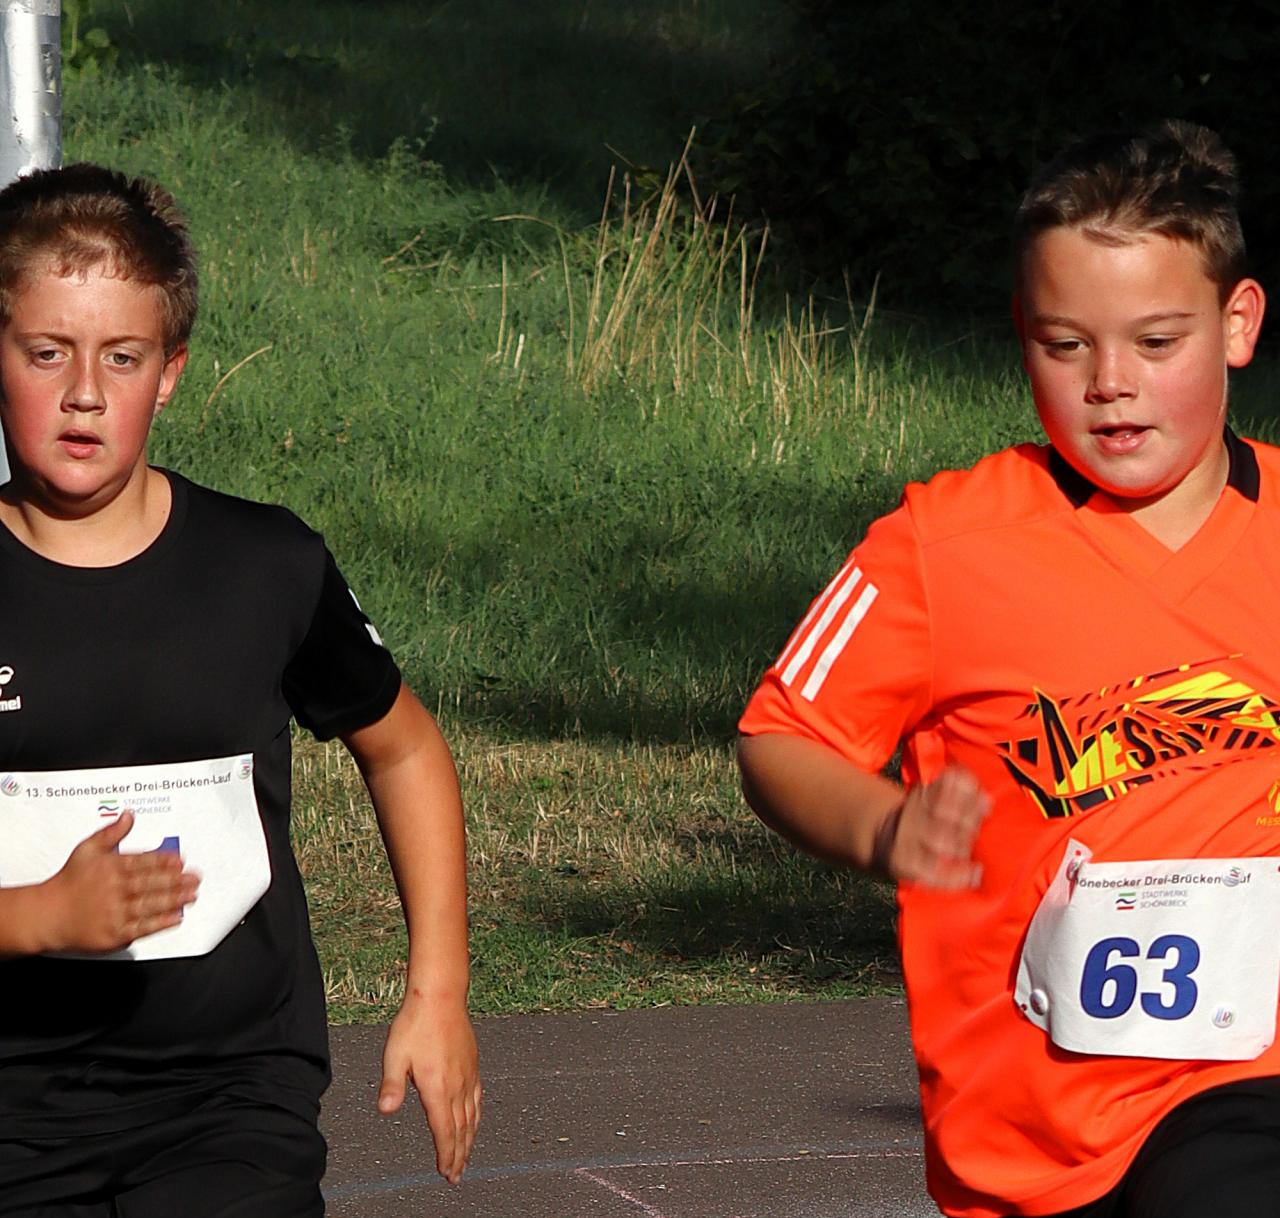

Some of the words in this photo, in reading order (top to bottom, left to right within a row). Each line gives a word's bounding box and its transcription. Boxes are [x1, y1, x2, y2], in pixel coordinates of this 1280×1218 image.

[25, 788, 43, 798] 13.
[46, 784, 130, 798] Schönebecker
[134, 773, 232, 792] Drei-Brücken-Lauf
[1141, 889, 1188, 899] STADTWERKE
[1079, 934, 1200, 1021] 63
